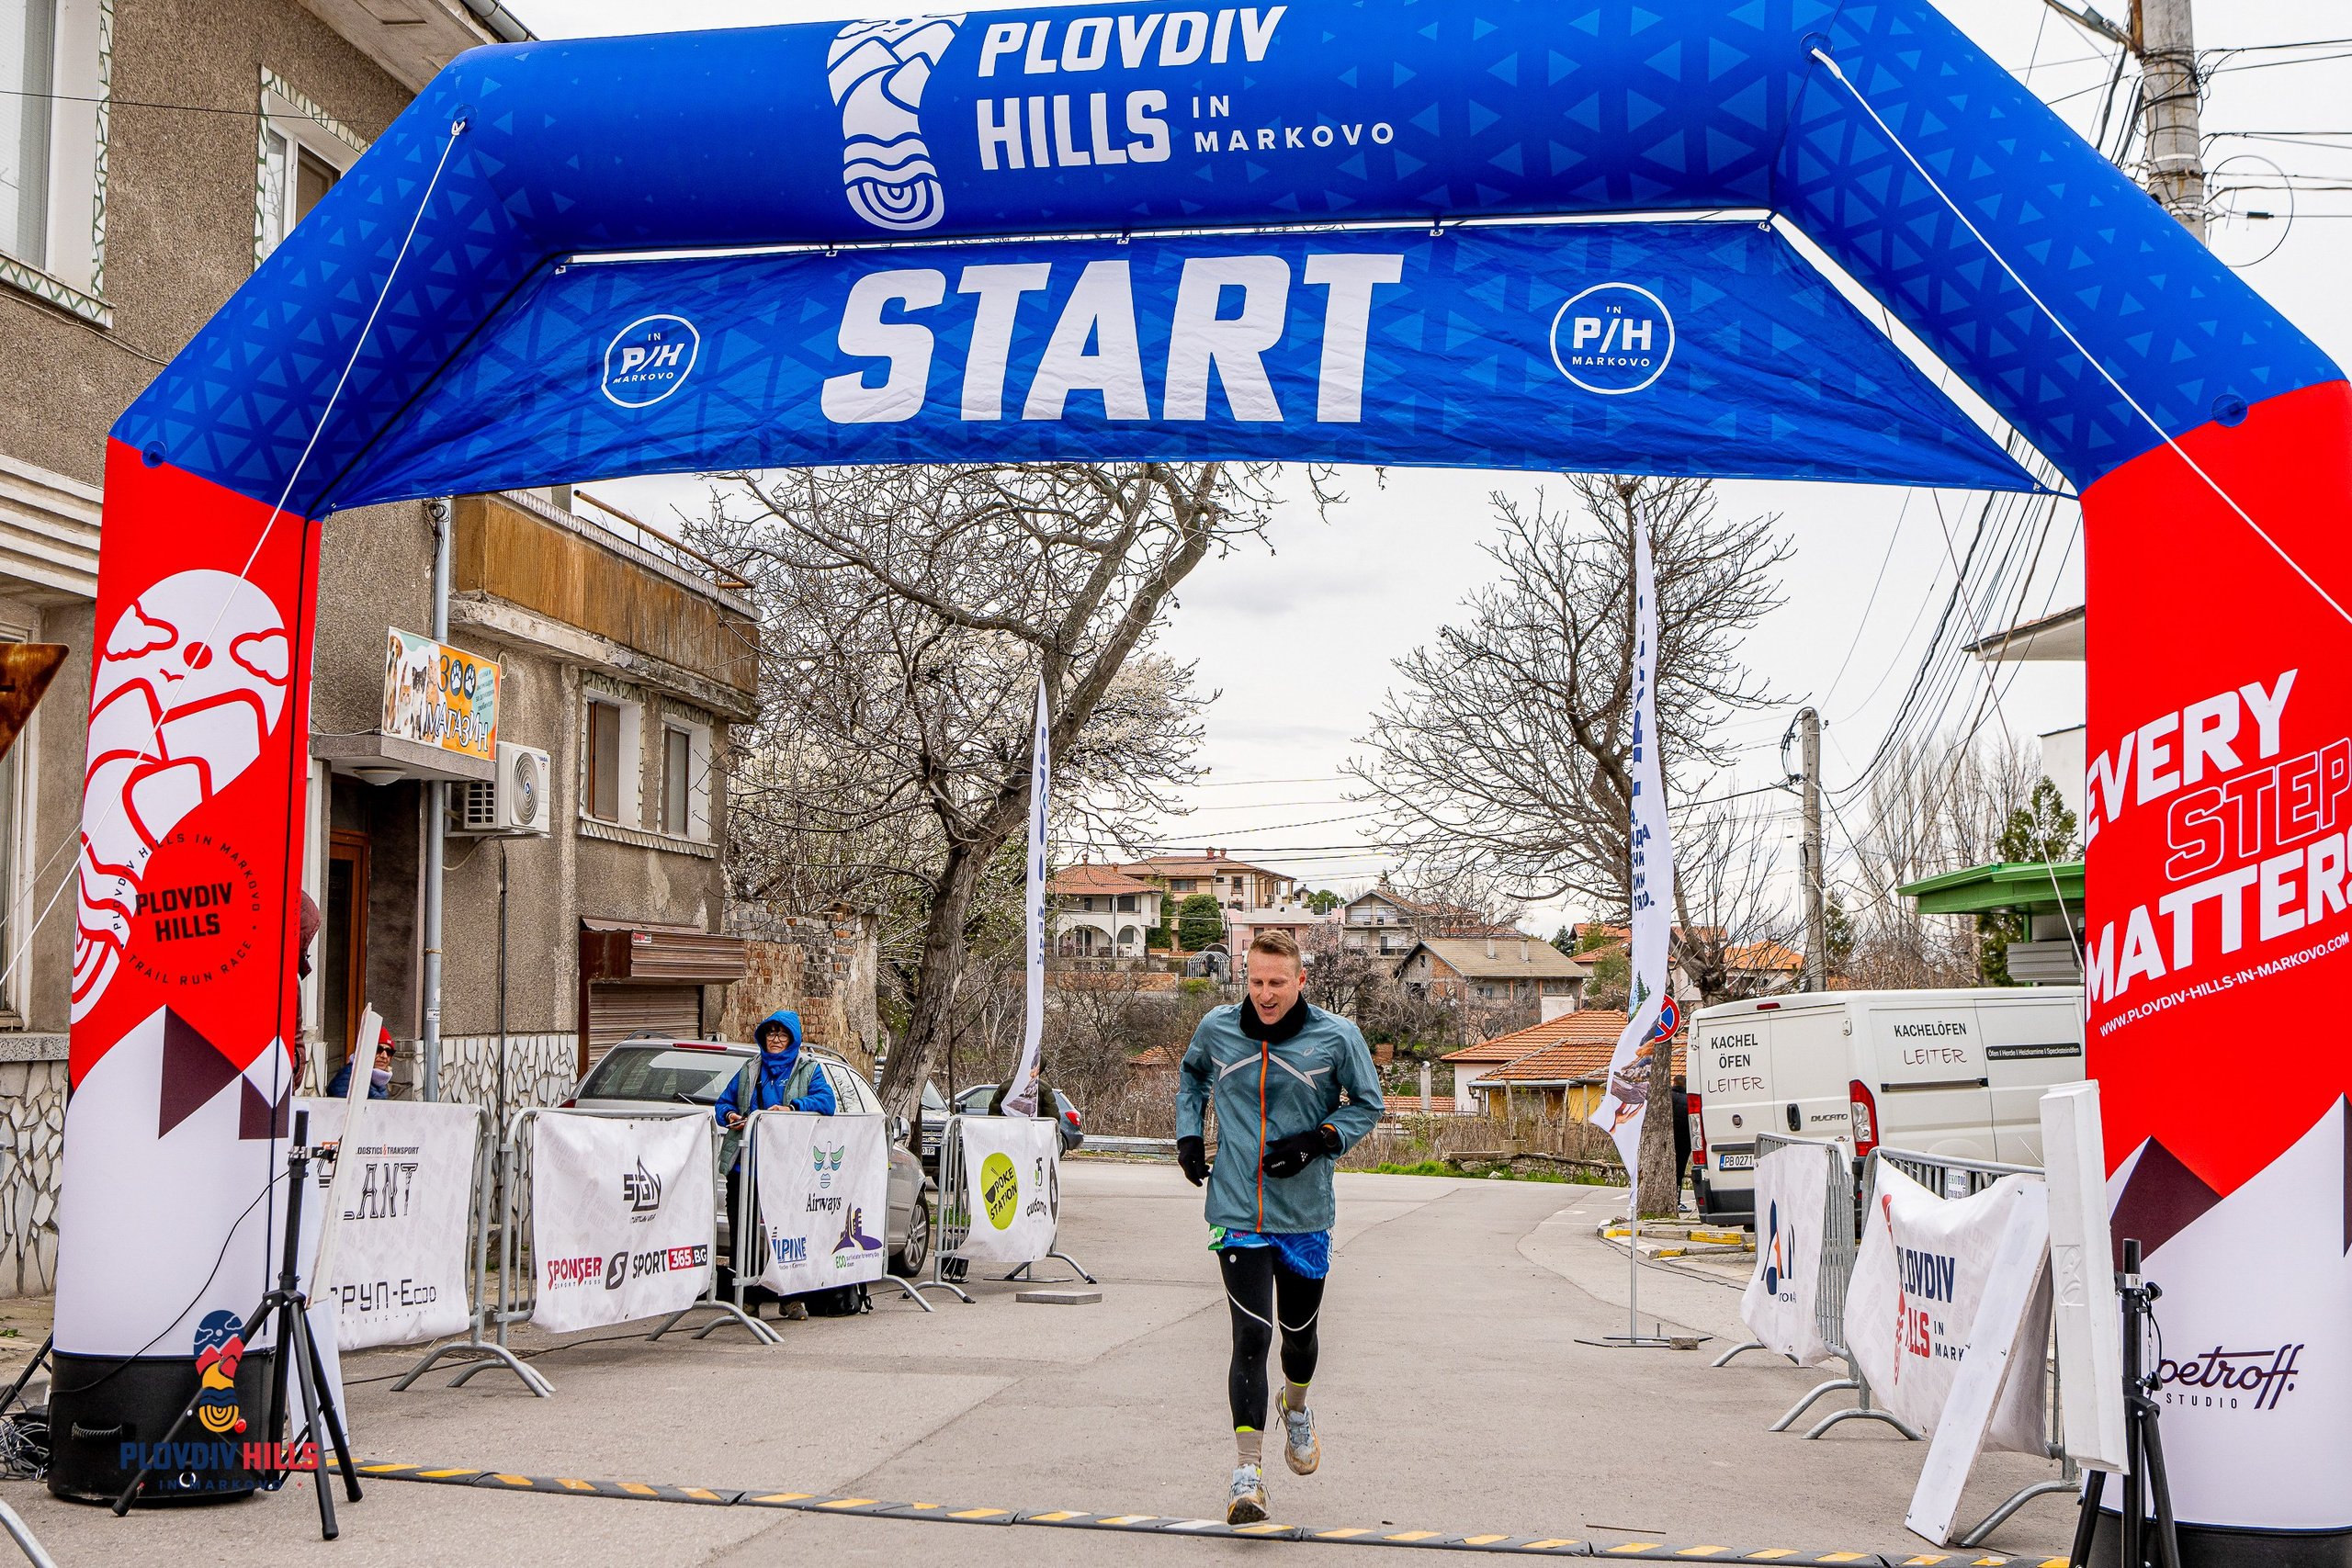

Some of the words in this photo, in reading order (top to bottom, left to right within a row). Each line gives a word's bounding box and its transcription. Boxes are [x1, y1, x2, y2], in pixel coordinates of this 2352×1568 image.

[978, 6, 1288, 77] PLOVDIV
[1193, 96, 1230, 118] IN
[976, 90, 1171, 171] HILLS
[1193, 122, 1395, 153] MARKOVO
[1605, 305, 1622, 314] IN
[648, 333, 662, 341] IN
[820, 254, 1405, 423] START
[1573, 317, 1653, 354] P/H
[619, 343, 685, 376] P/H
[1572, 355, 1650, 367] MARKOVO
[612, 371, 674, 384] MARKOVO
[424, 702, 489, 751] МАГАЗИН
[2086, 668, 2299, 852] EVERY
[2165, 738, 2351, 882] STEP
[112, 860, 136, 931] PLOVDIV
[139, 833, 185, 858] HILLS
[195, 834, 212, 845] IN
[220, 842, 260, 912] MARKOVO
[135, 882, 232, 917] PLOVDIV
[154, 913, 221, 942] HILLS
[2086, 824, 2352, 1023] MATTER
[128, 954, 169, 984] TRAIL
[179, 972, 213, 986] RUN
[220, 940, 252, 974] RACE
[2099, 931, 2350, 1037] WWW.PLOVDIV-HILLS-IN-MARKOVO.COM
[1711, 1033, 1758, 1049] KACHEL
[1894, 1021, 1967, 1037] KACHELÖFEN
[1719, 1054, 1751, 1068] ÖFEN
[1904, 1048, 1968, 1065] LEITER
[1707, 1077, 1765, 1093] LEITER
[1811, 1113, 1848, 1122] DUCATO
[387, 1146, 419, 1156] TRANSPORT
[1724, 1156, 1735, 1166] PB
[1735, 1155, 1753, 1166] 0271
[344, 1163, 419, 1220] ANT
[994, 1167, 1014, 1193] POKE
[806, 1193, 842, 1215] Airways
[990, 1182, 1018, 1220] STATION
[547, 1257, 603, 1291] SPONSER
[835, 1255, 847, 1269] ECO
[1934, 1320, 1944, 1336] IN
[1935, 1343, 1964, 1361] MARK
[2165, 1393, 2238, 1409] STUDIO
